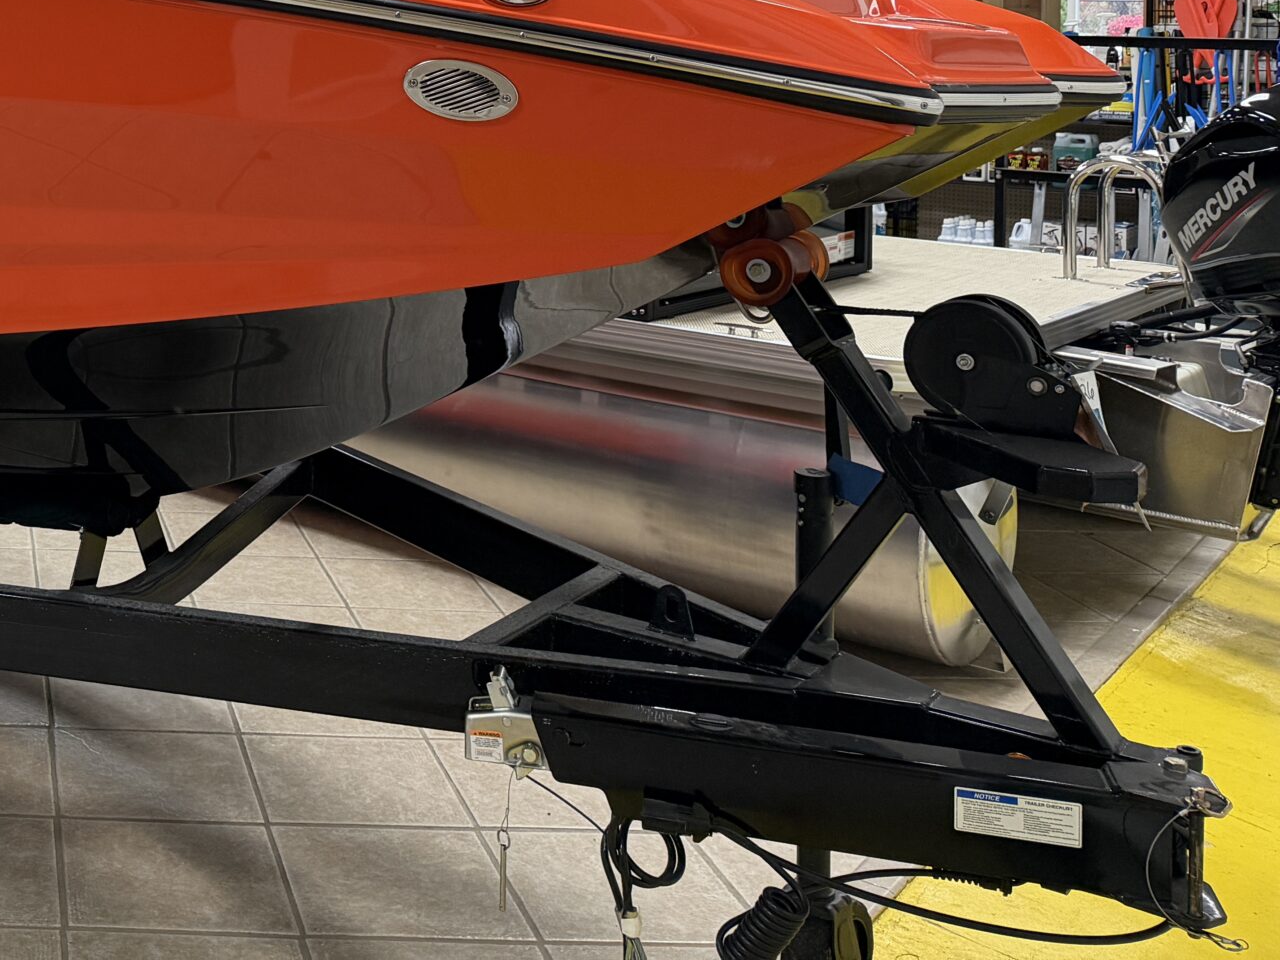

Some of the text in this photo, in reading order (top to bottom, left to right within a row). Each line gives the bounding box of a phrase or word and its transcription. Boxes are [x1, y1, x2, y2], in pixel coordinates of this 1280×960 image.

[1177, 161, 1257, 252] MERCURY
[974, 792, 1001, 803] NOTICE
[1024, 800, 1047, 808] TRAILER
